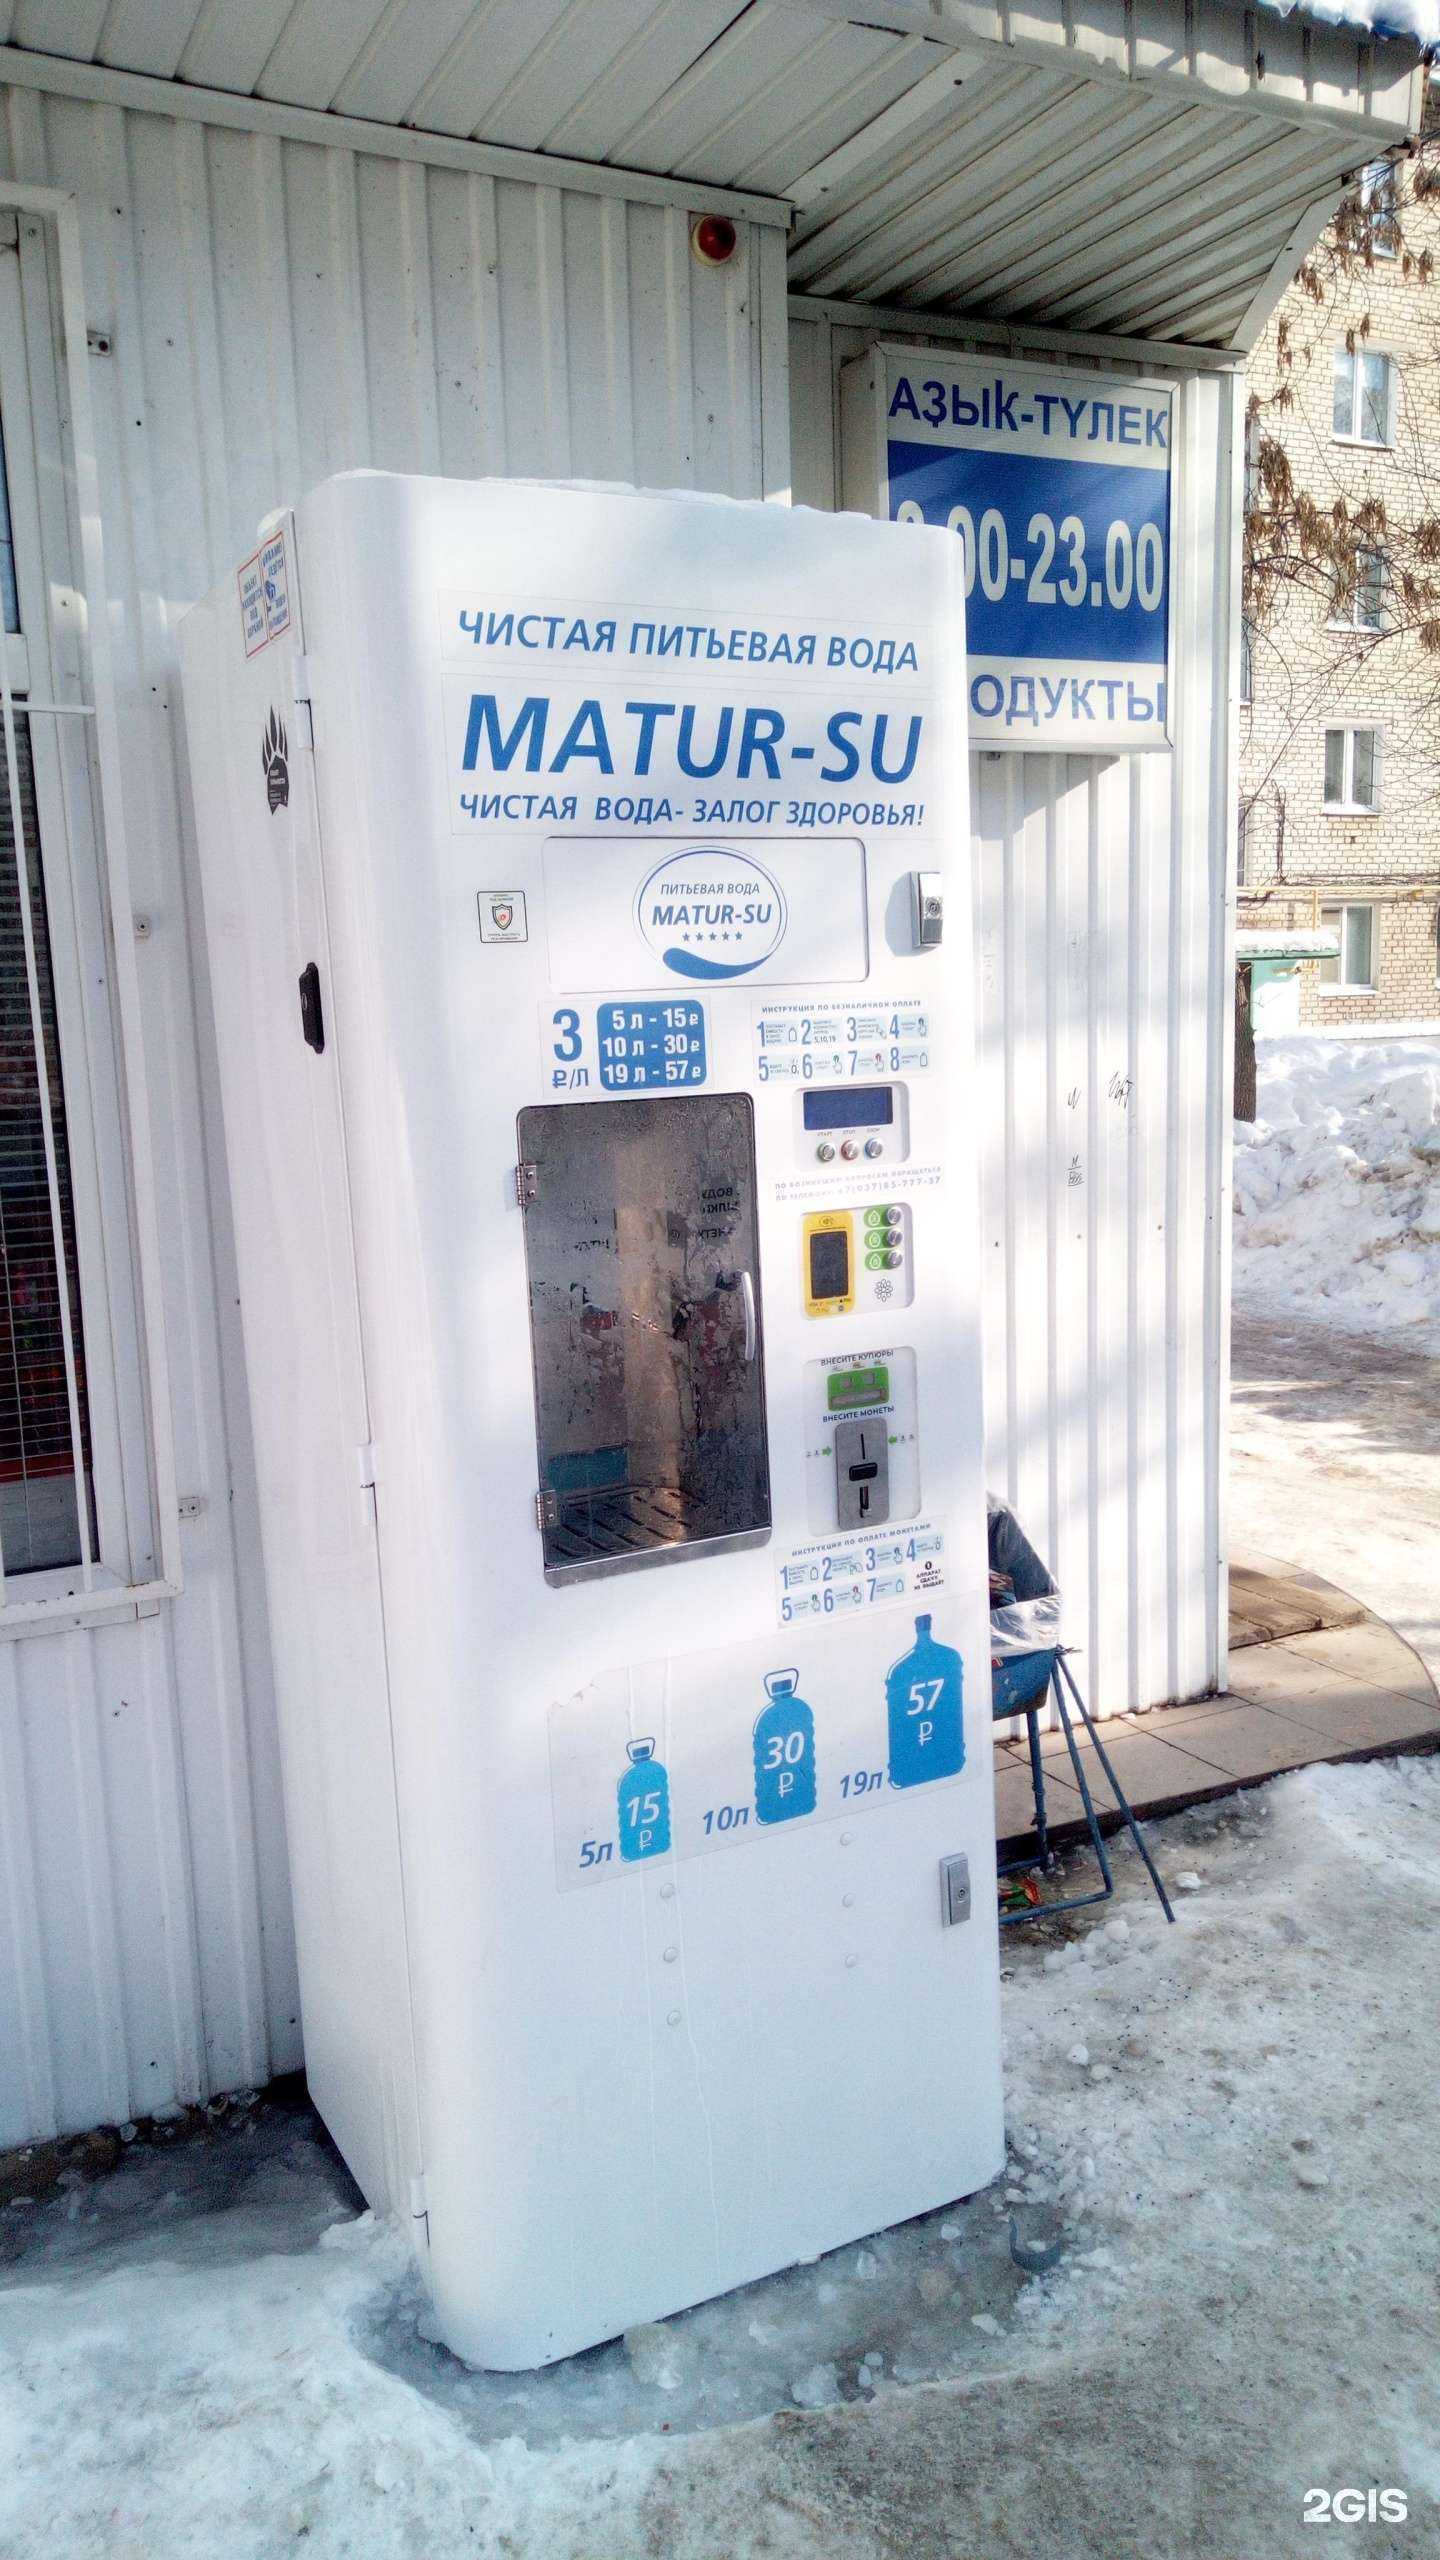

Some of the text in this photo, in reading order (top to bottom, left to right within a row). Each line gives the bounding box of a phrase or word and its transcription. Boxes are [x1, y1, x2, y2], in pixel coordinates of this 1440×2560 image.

[459, 610, 919, 675] ЧИСТАЯ ПИТЬЕВАЯ ВОДА
[461, 694, 923, 784] MATUR-SU
[460, 794, 924, 827] ЧИСТАЯ ВОДА- ЗАЛОГ ЗДОРОВЬЯ!
[660, 882, 760, 895] ПИТЬЕВАЯ ВОДА
[652, 903, 772, 925] MATUR-SU
[612, 1010, 625, 1030] 5
[630, 1014, 643, 1030] л
[663, 1008, 687, 1028] 15
[762, 1004, 815, 1013] ИНСТРУКЦИЯ
[818, 1003, 829, 1011] ПО
[553, 1009, 583, 1062] 3
[757, 1021, 766, 1047] 1
[801, 1019, 811, 1045] 2
[847, 1017, 857, 1041] 3
[889, 1014, 899, 1039] 4
[603, 1037, 626, 1057] 10
[632, 1041, 645, 1056] л
[664, 1034, 687, 1054] 30
[759, 1055, 769, 1081] 5
[802, 1053, 813, 1079] 6
[848, 1050, 858, 1076] 7
[890, 1047, 900, 1071] 8
[604, 1064, 628, 1084] 19
[634, 1067, 646, 1083] л
[666, 1060, 688, 1080] 57
[820, 1355, 856, 1366] ВНЕСИТЕ
[859, 1349, 894, 1361] КУПЮРЫ
[822, 1405, 895, 1422] ВНЕСИТЕ МОНЕТЫ
[791, 1542, 841, 1556] ИНСТРУКЦИЯ
[858, 1532, 887, 1543] ОПЛАТЕ
[906, 1538, 917, 1561] 4
[822, 1557, 832, 1582] 2
[866, 1547, 876, 1571] 3
[779, 1565, 789, 1589] 1
[824, 1588, 834, 1612] 6
[866, 1578, 877, 1602] 7
[782, 1597, 792, 1621] 5
[907, 1678, 944, 1716] 57
[763, 1731, 805, 1770] 30
[840, 1770, 883, 1799] 19л
[626, 1791, 661, 1828] 15
[702, 1805, 750, 1836] 10л
[579, 1841, 613, 1868] 5л
